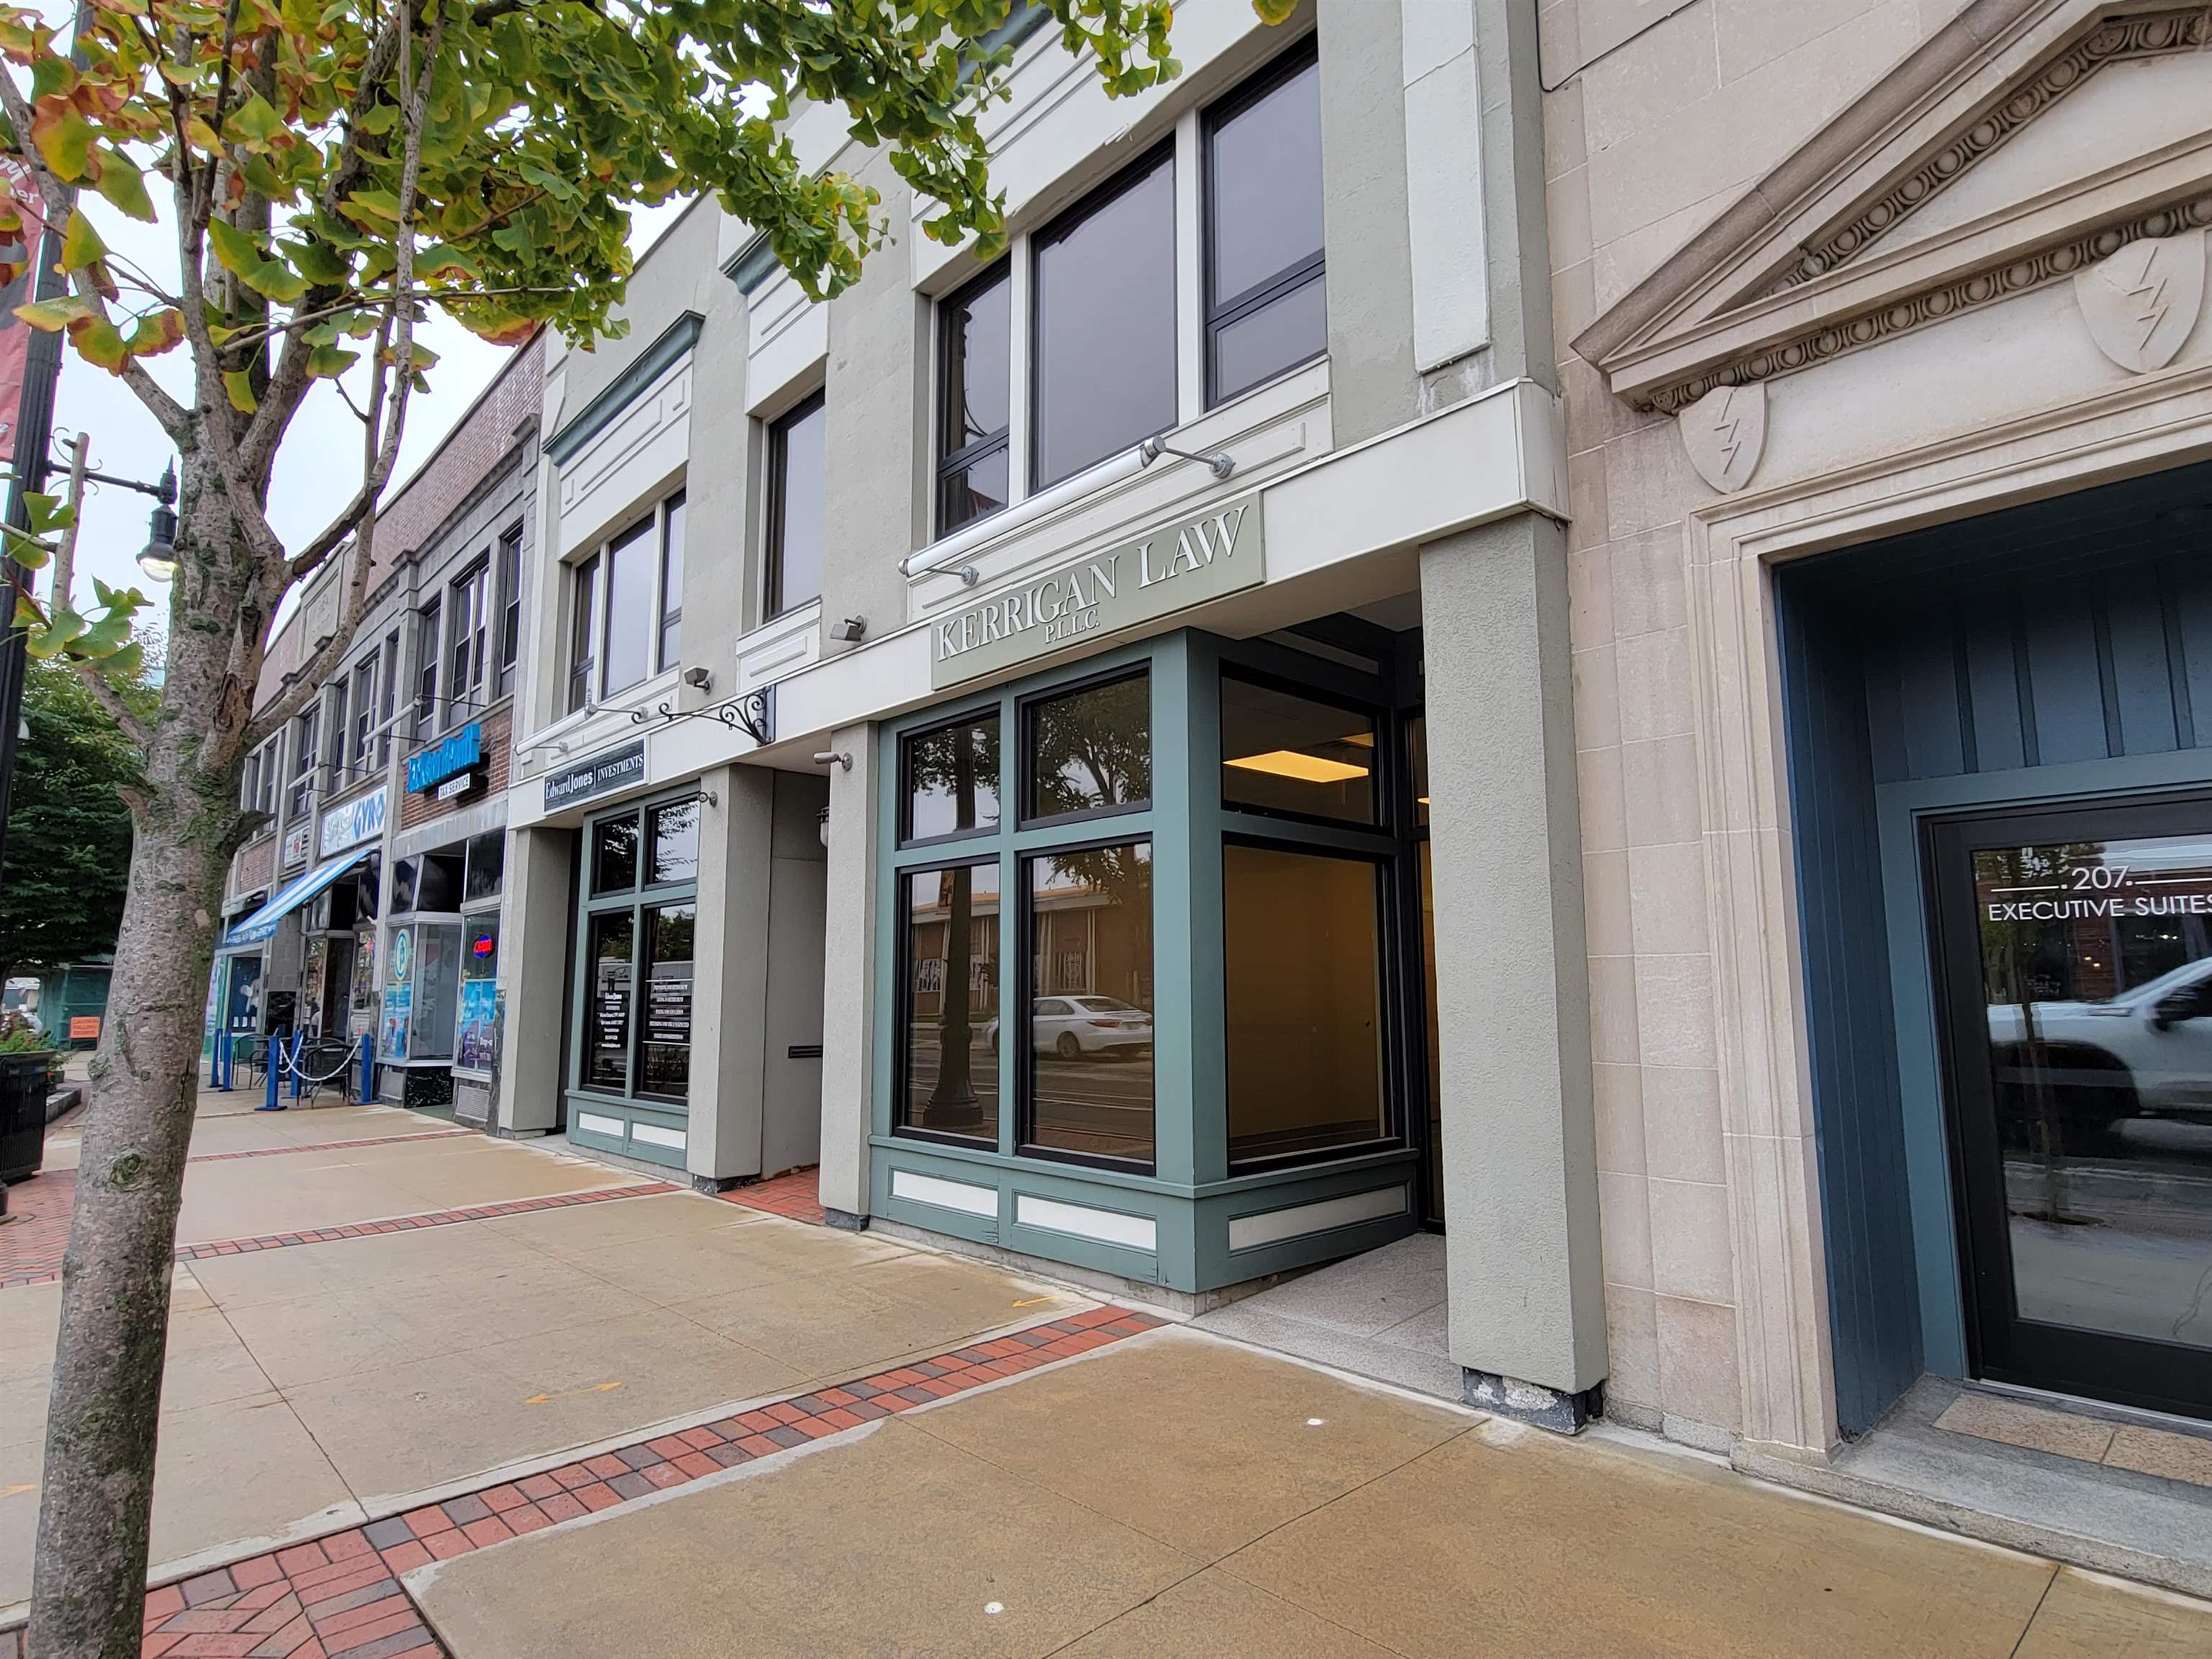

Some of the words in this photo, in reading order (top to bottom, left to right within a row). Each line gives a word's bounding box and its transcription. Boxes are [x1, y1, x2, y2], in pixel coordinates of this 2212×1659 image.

[936, 554, 1120, 662] KERRIGAN
[1136, 504, 1249, 590] LAW
[597, 753, 644, 782] INVESTMENTS
[449, 775, 469, 793] SERVICE
[2071, 864, 2131, 891] 207
[1988, 898, 2125, 922] EXECUTIVE
